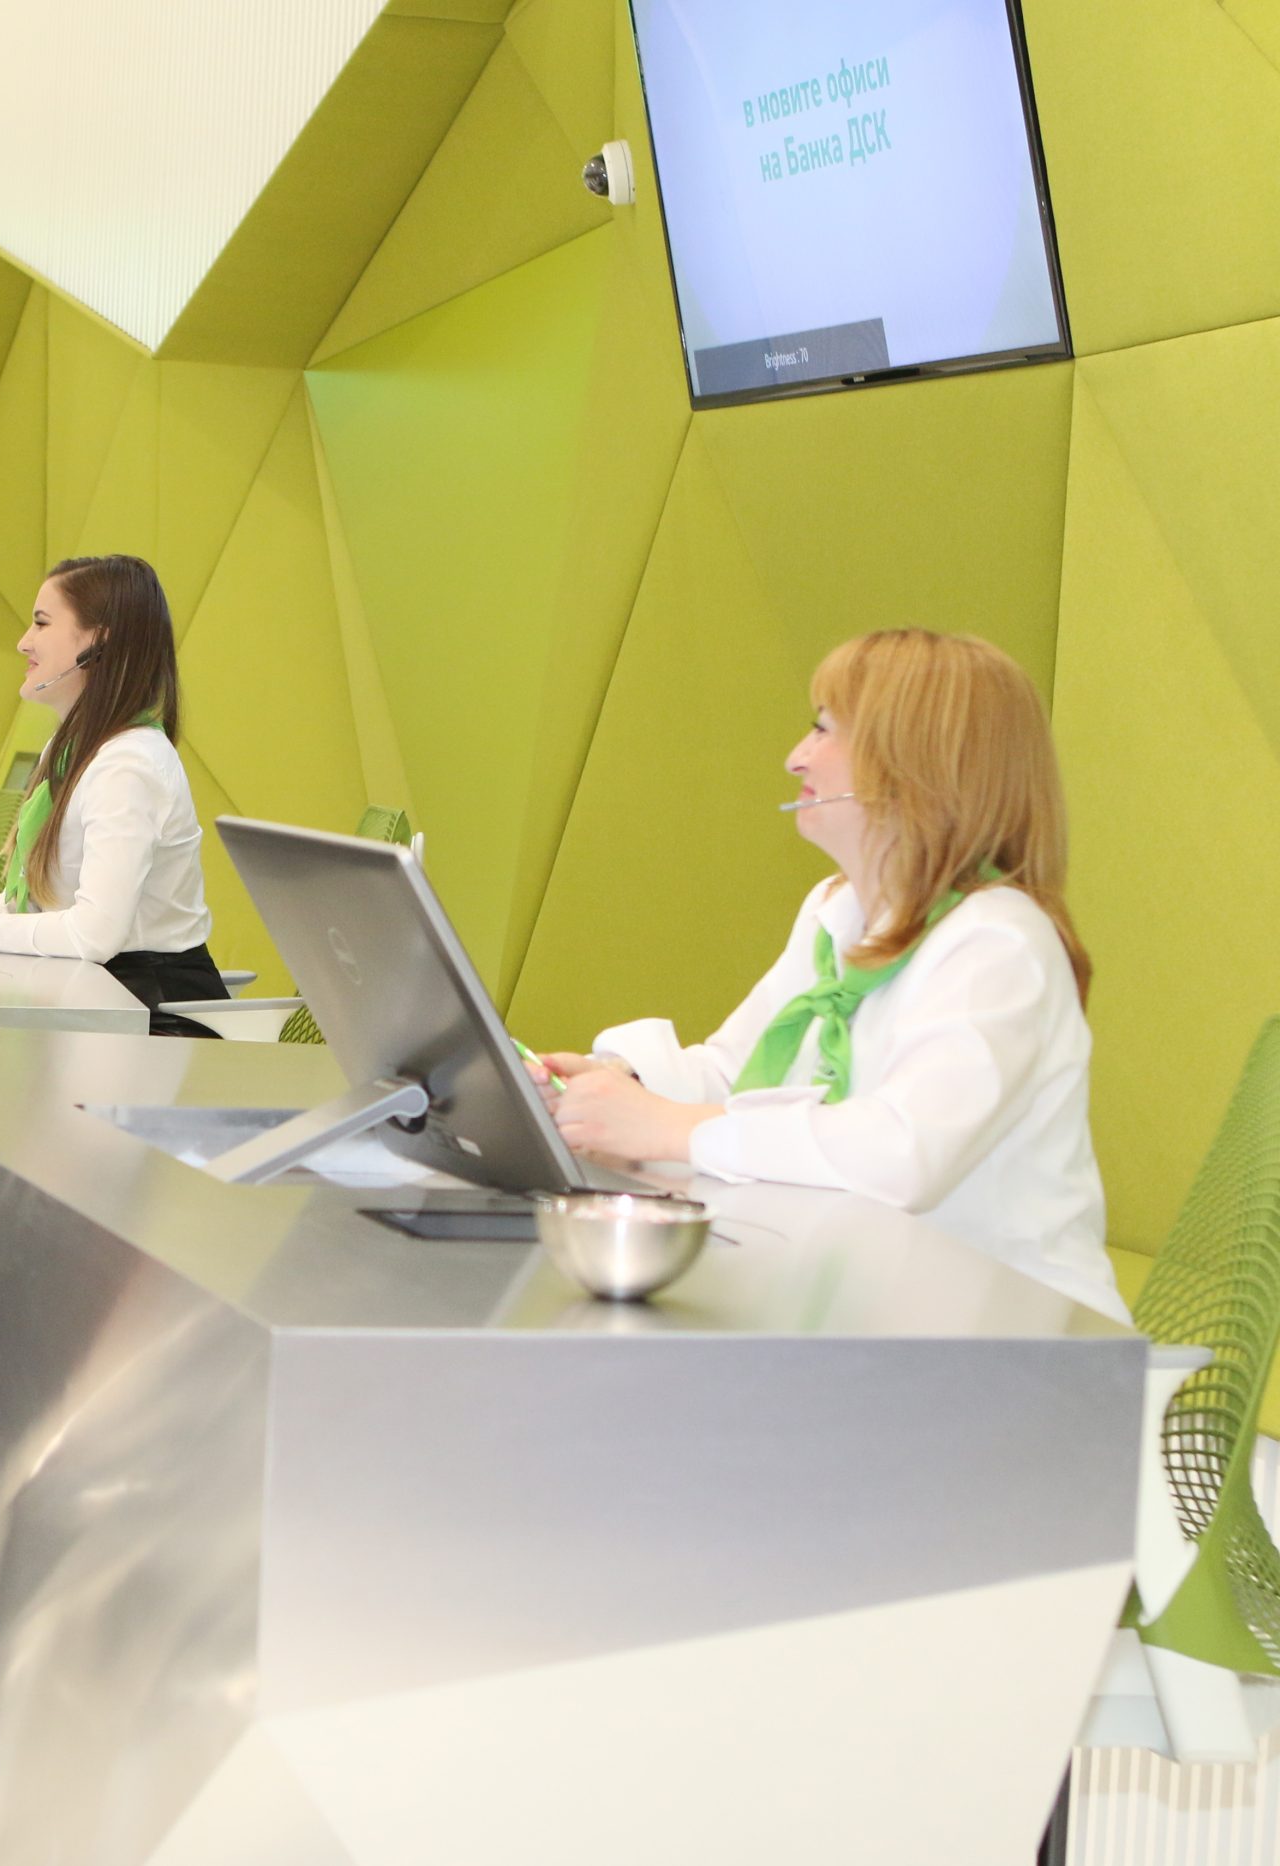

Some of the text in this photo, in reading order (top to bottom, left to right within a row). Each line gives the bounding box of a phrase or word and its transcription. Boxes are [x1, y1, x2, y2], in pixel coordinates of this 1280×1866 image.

[743, 56, 890, 128] в новите офиси
[759, 108, 892, 183] на Банка ДСК
[799, 347, 809, 364] 70
